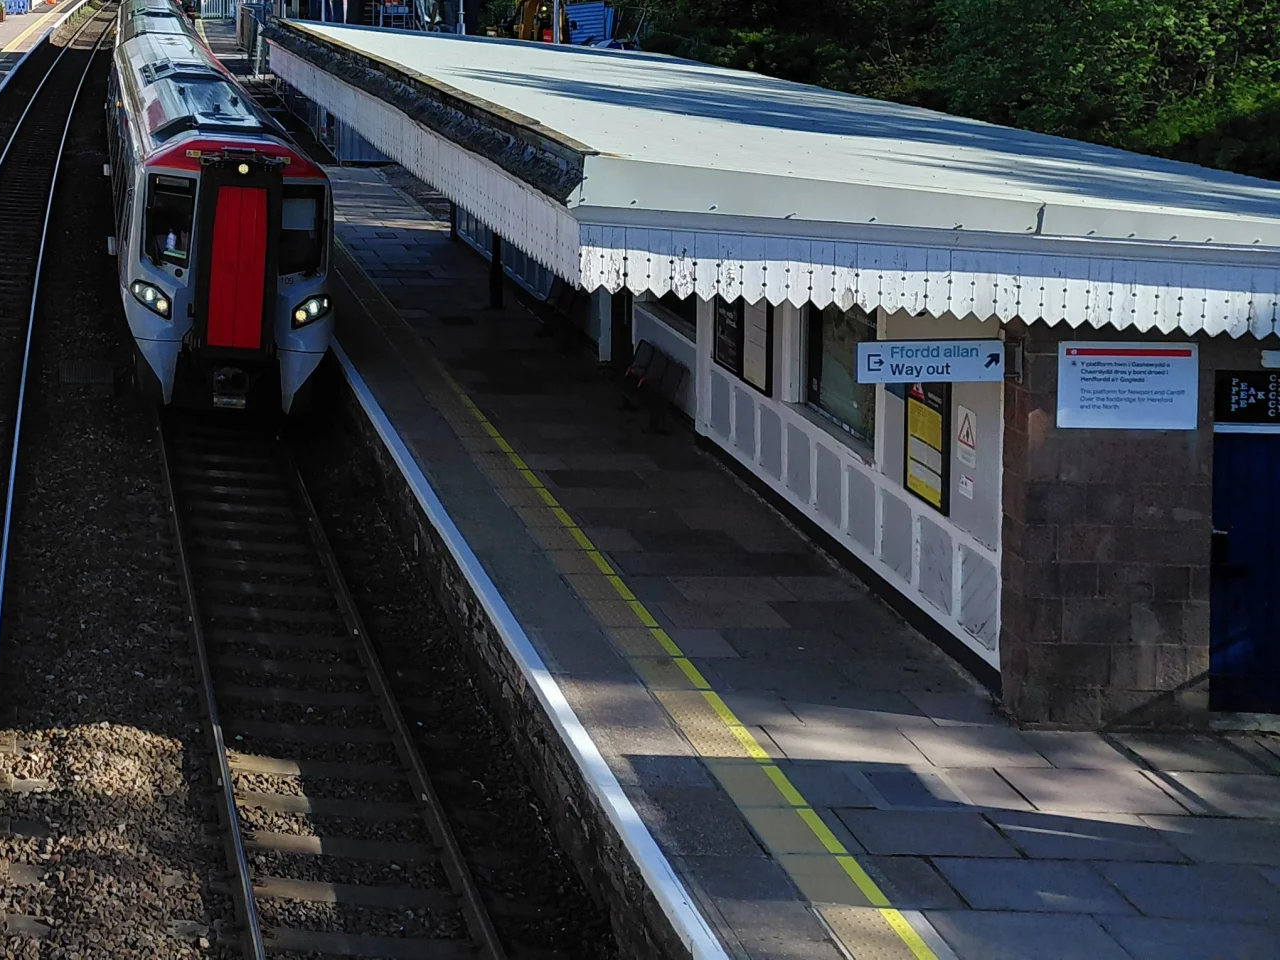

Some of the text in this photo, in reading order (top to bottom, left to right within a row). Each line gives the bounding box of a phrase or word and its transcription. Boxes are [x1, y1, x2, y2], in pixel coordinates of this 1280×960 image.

[281, 277, 294, 285] 109
[890, 345, 979, 359] Ffordd allan
[890, 363, 951, 378] Way out
